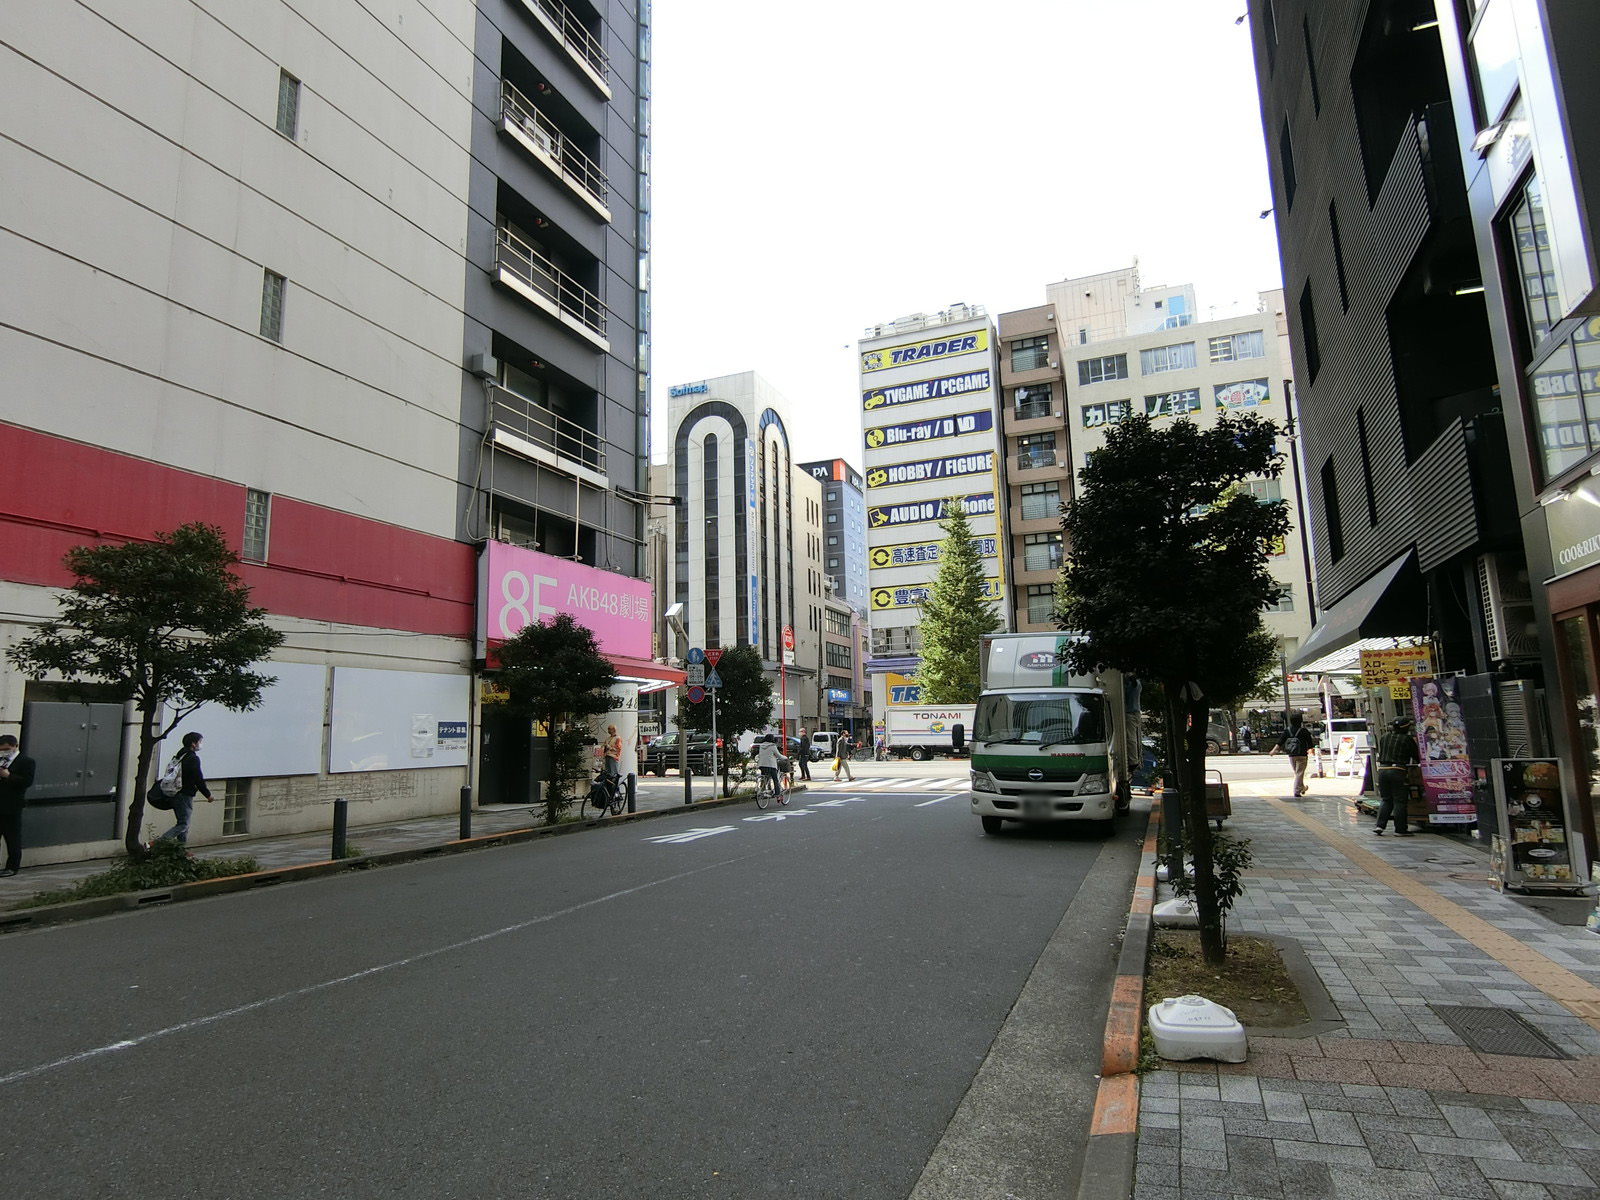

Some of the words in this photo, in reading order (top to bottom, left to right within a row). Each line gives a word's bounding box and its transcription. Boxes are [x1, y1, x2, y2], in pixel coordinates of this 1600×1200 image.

[891, 335, 977, 364] TRADER
[884, 383, 929, 404] TVGAME
[941, 373, 989, 395] PCGAME
[886, 424, 932, 443] Blu-ray
[888, 463, 933, 483] HOBBY
[945, 454, 993, 475] FIGURE
[890, 503, 934, 523] AUDIO
[567, 583, 649, 622] AKB48劇場
[1365, 668, 1414, 677] エレベーターは
[1366, 676, 1390, 685] こちら
[913, 712, 962, 720] TONAMI
